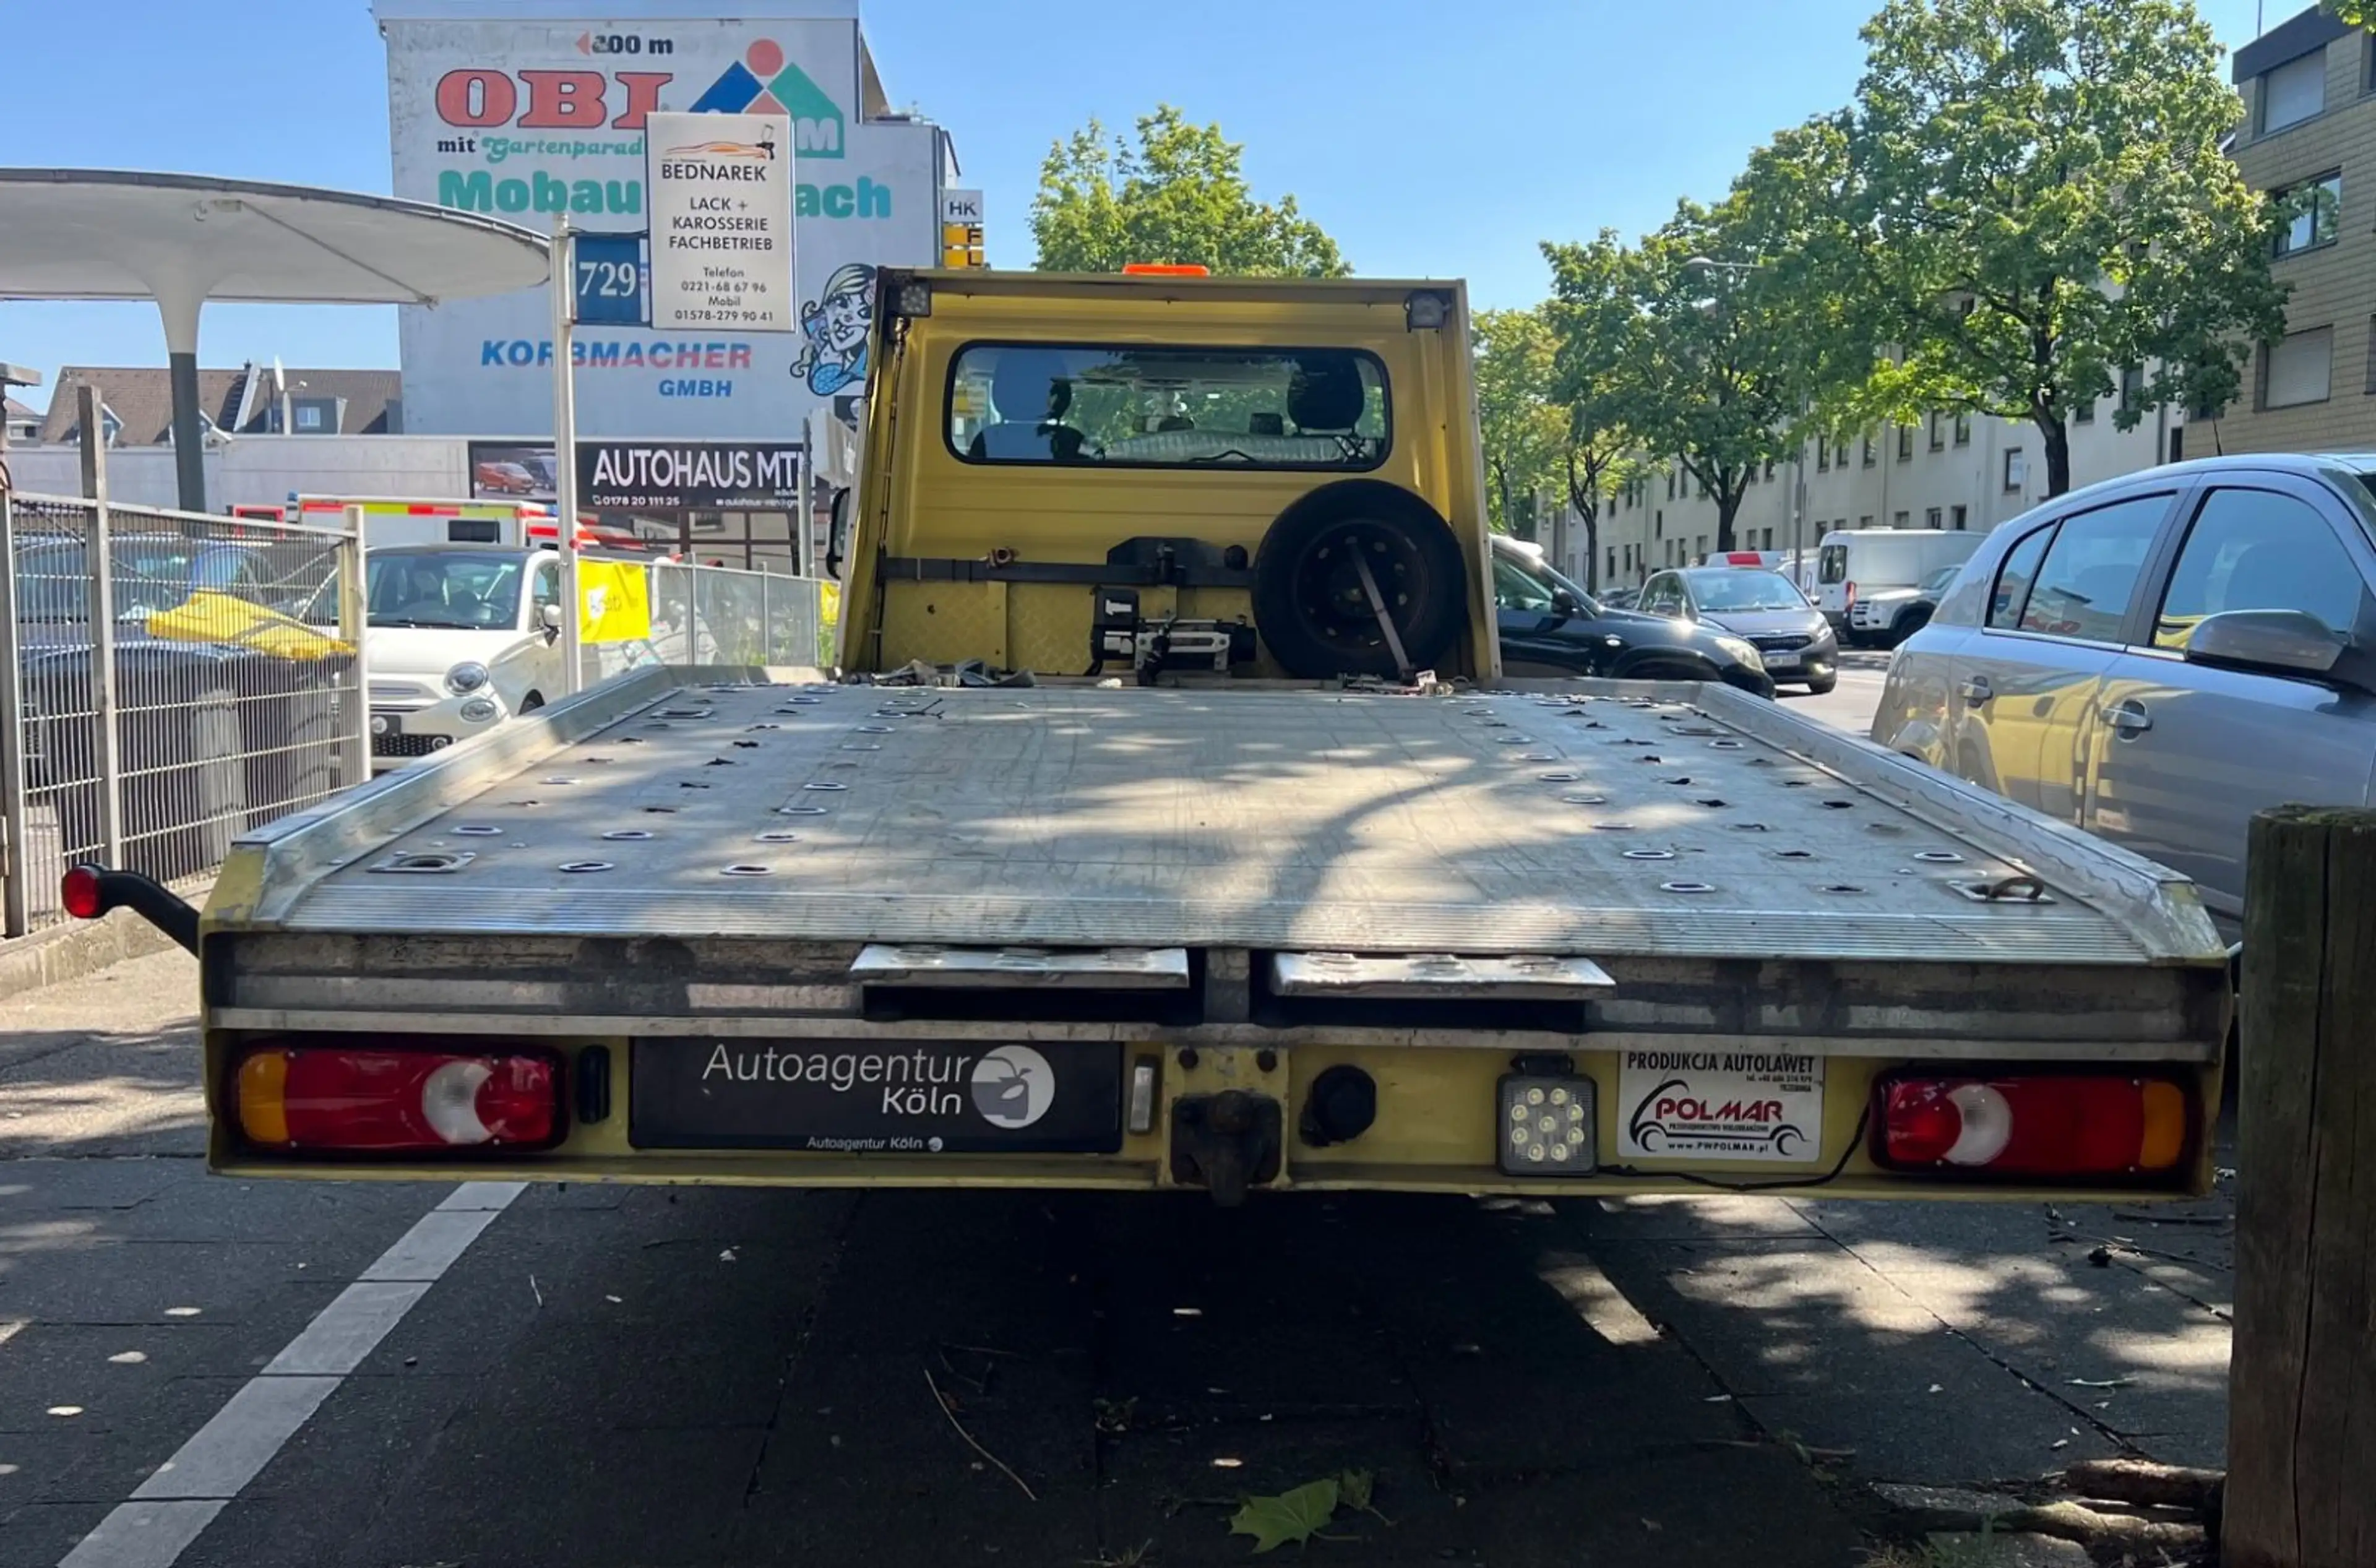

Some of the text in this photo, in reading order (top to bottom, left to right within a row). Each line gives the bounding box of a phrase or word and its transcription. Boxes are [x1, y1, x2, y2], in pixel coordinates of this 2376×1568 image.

[648, 38, 674, 54] m
[435, 69, 674, 130] OBI
[437, 136, 476, 153] mit
[661, 163, 767, 182] BEDNAREK
[689, 196, 731, 212] LACK
[949, 200, 978, 217] HK
[672, 216, 768, 231] KAROSSERIE
[669, 235, 773, 251] FACHBETRIEB
[579, 261, 637, 297] 729
[703, 267, 745, 278] Telefon
[681, 280, 767, 293] 0221-68 67 96
[708, 296, 741, 306] Mobil
[674, 309, 773, 322] 01578-279 90 41
[658, 379, 733, 397] GMBH
[592, 449, 752, 488] AUTOHAUS
[631, 496, 646, 506] 20
[702, 1043, 972, 1093] Autoagentur
[1627, 1052, 1815, 1074] PRODUKCJA AUTOLAWET
[881, 1085, 962, 1115] Köln
[1655, 1097, 1783, 1123] POLMAR
[806, 1135, 923, 1150] Autoagentur Köln
